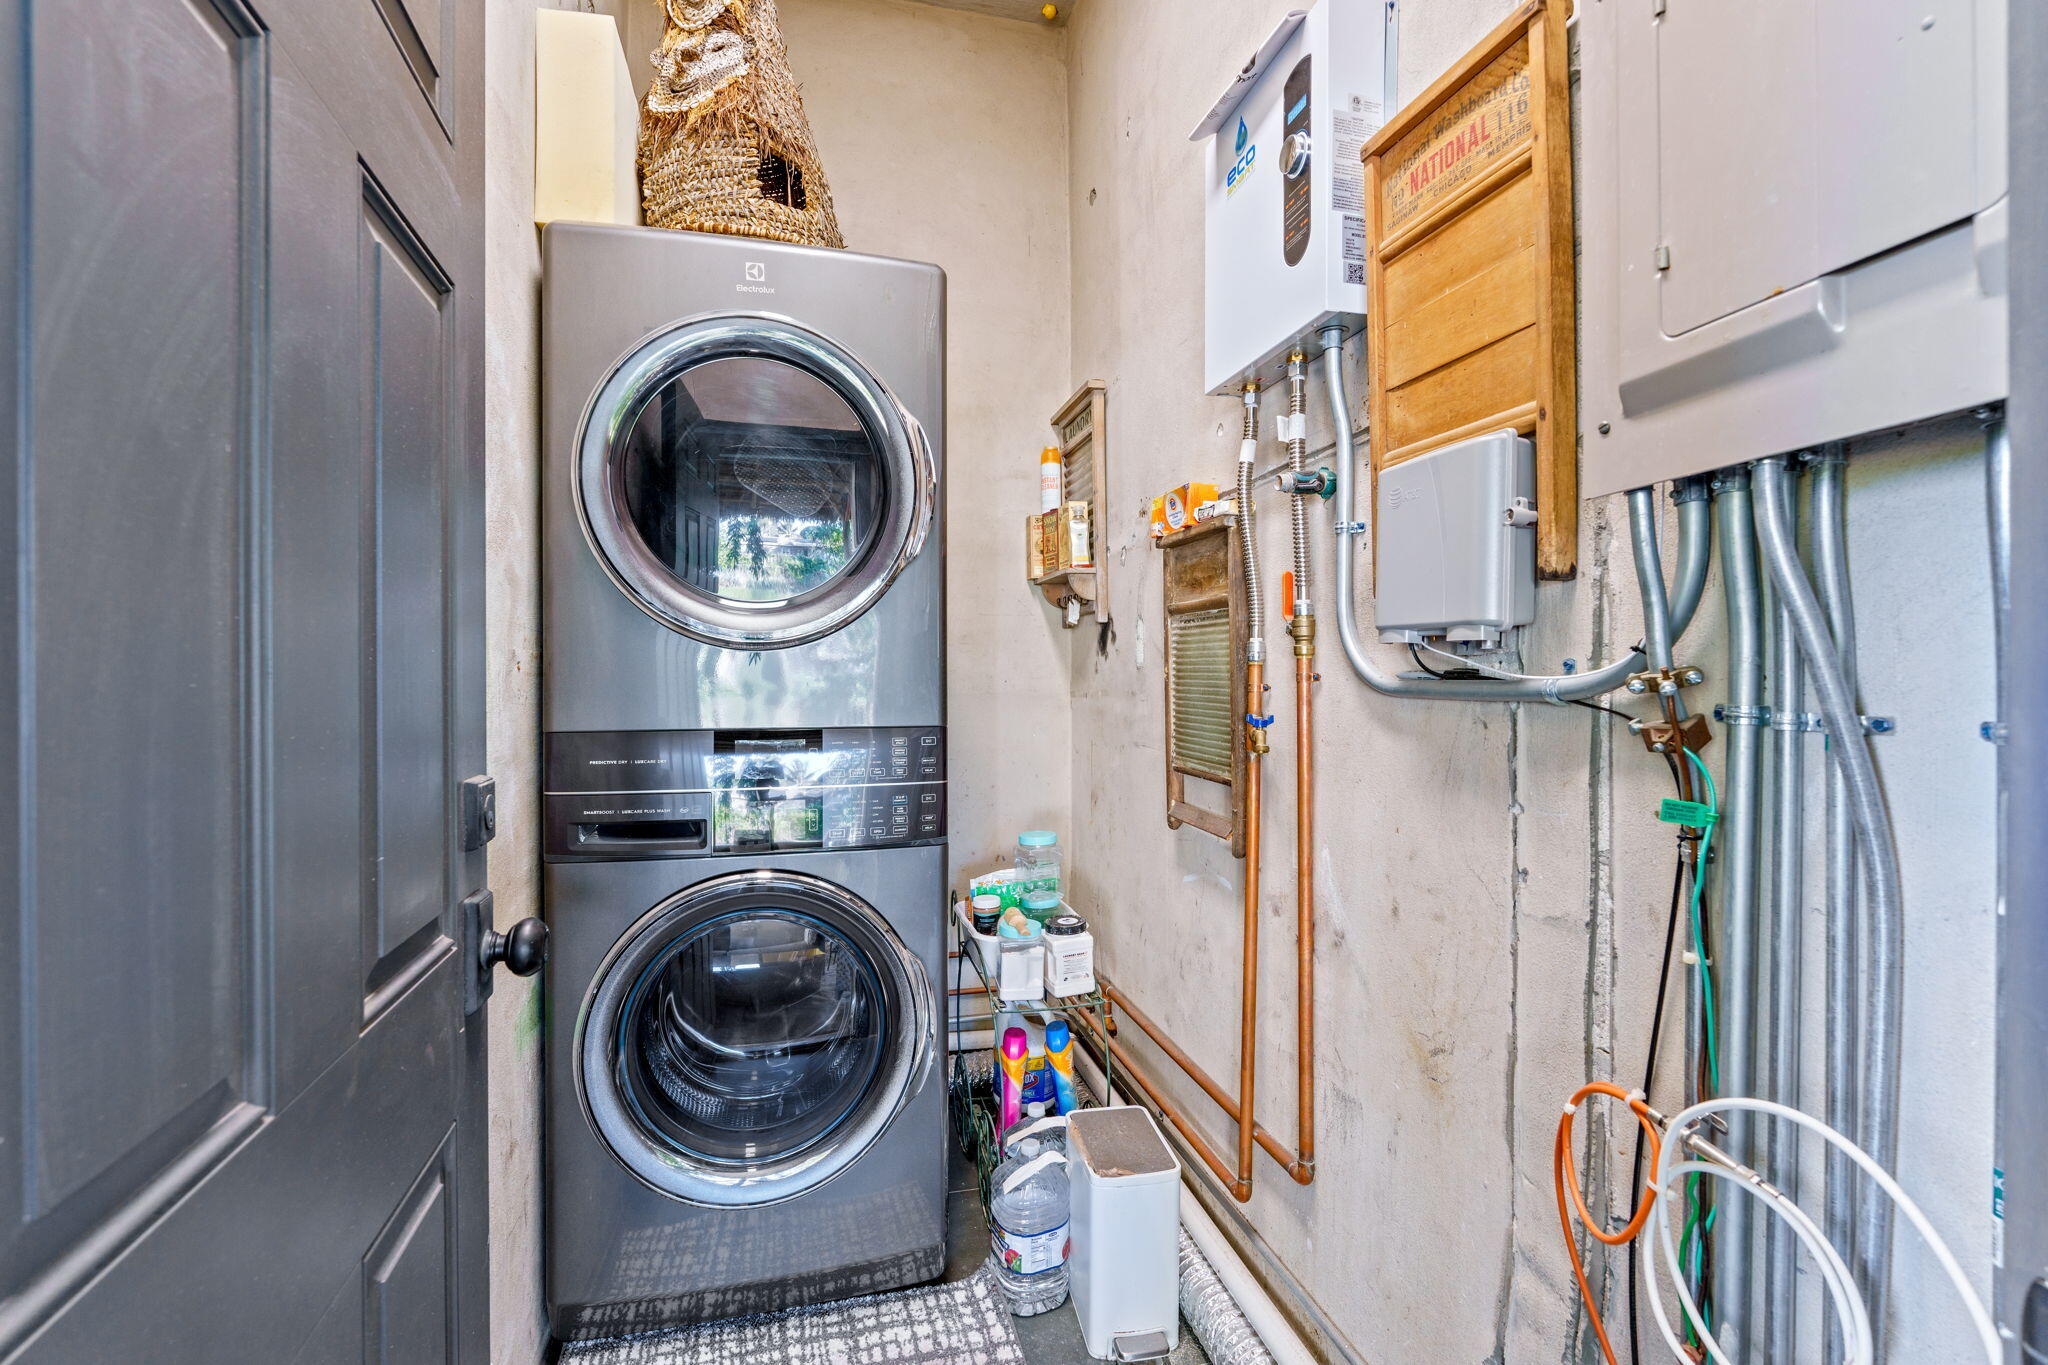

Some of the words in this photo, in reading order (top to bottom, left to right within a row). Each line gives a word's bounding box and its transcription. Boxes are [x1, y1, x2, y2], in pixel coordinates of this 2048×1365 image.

[1227, 145, 1256, 188] eco
[1410, 114, 1491, 196] NATIONAL
[1433, 165, 1472, 197] CHICAGO
[736, 284, 775, 294] Electrolux
